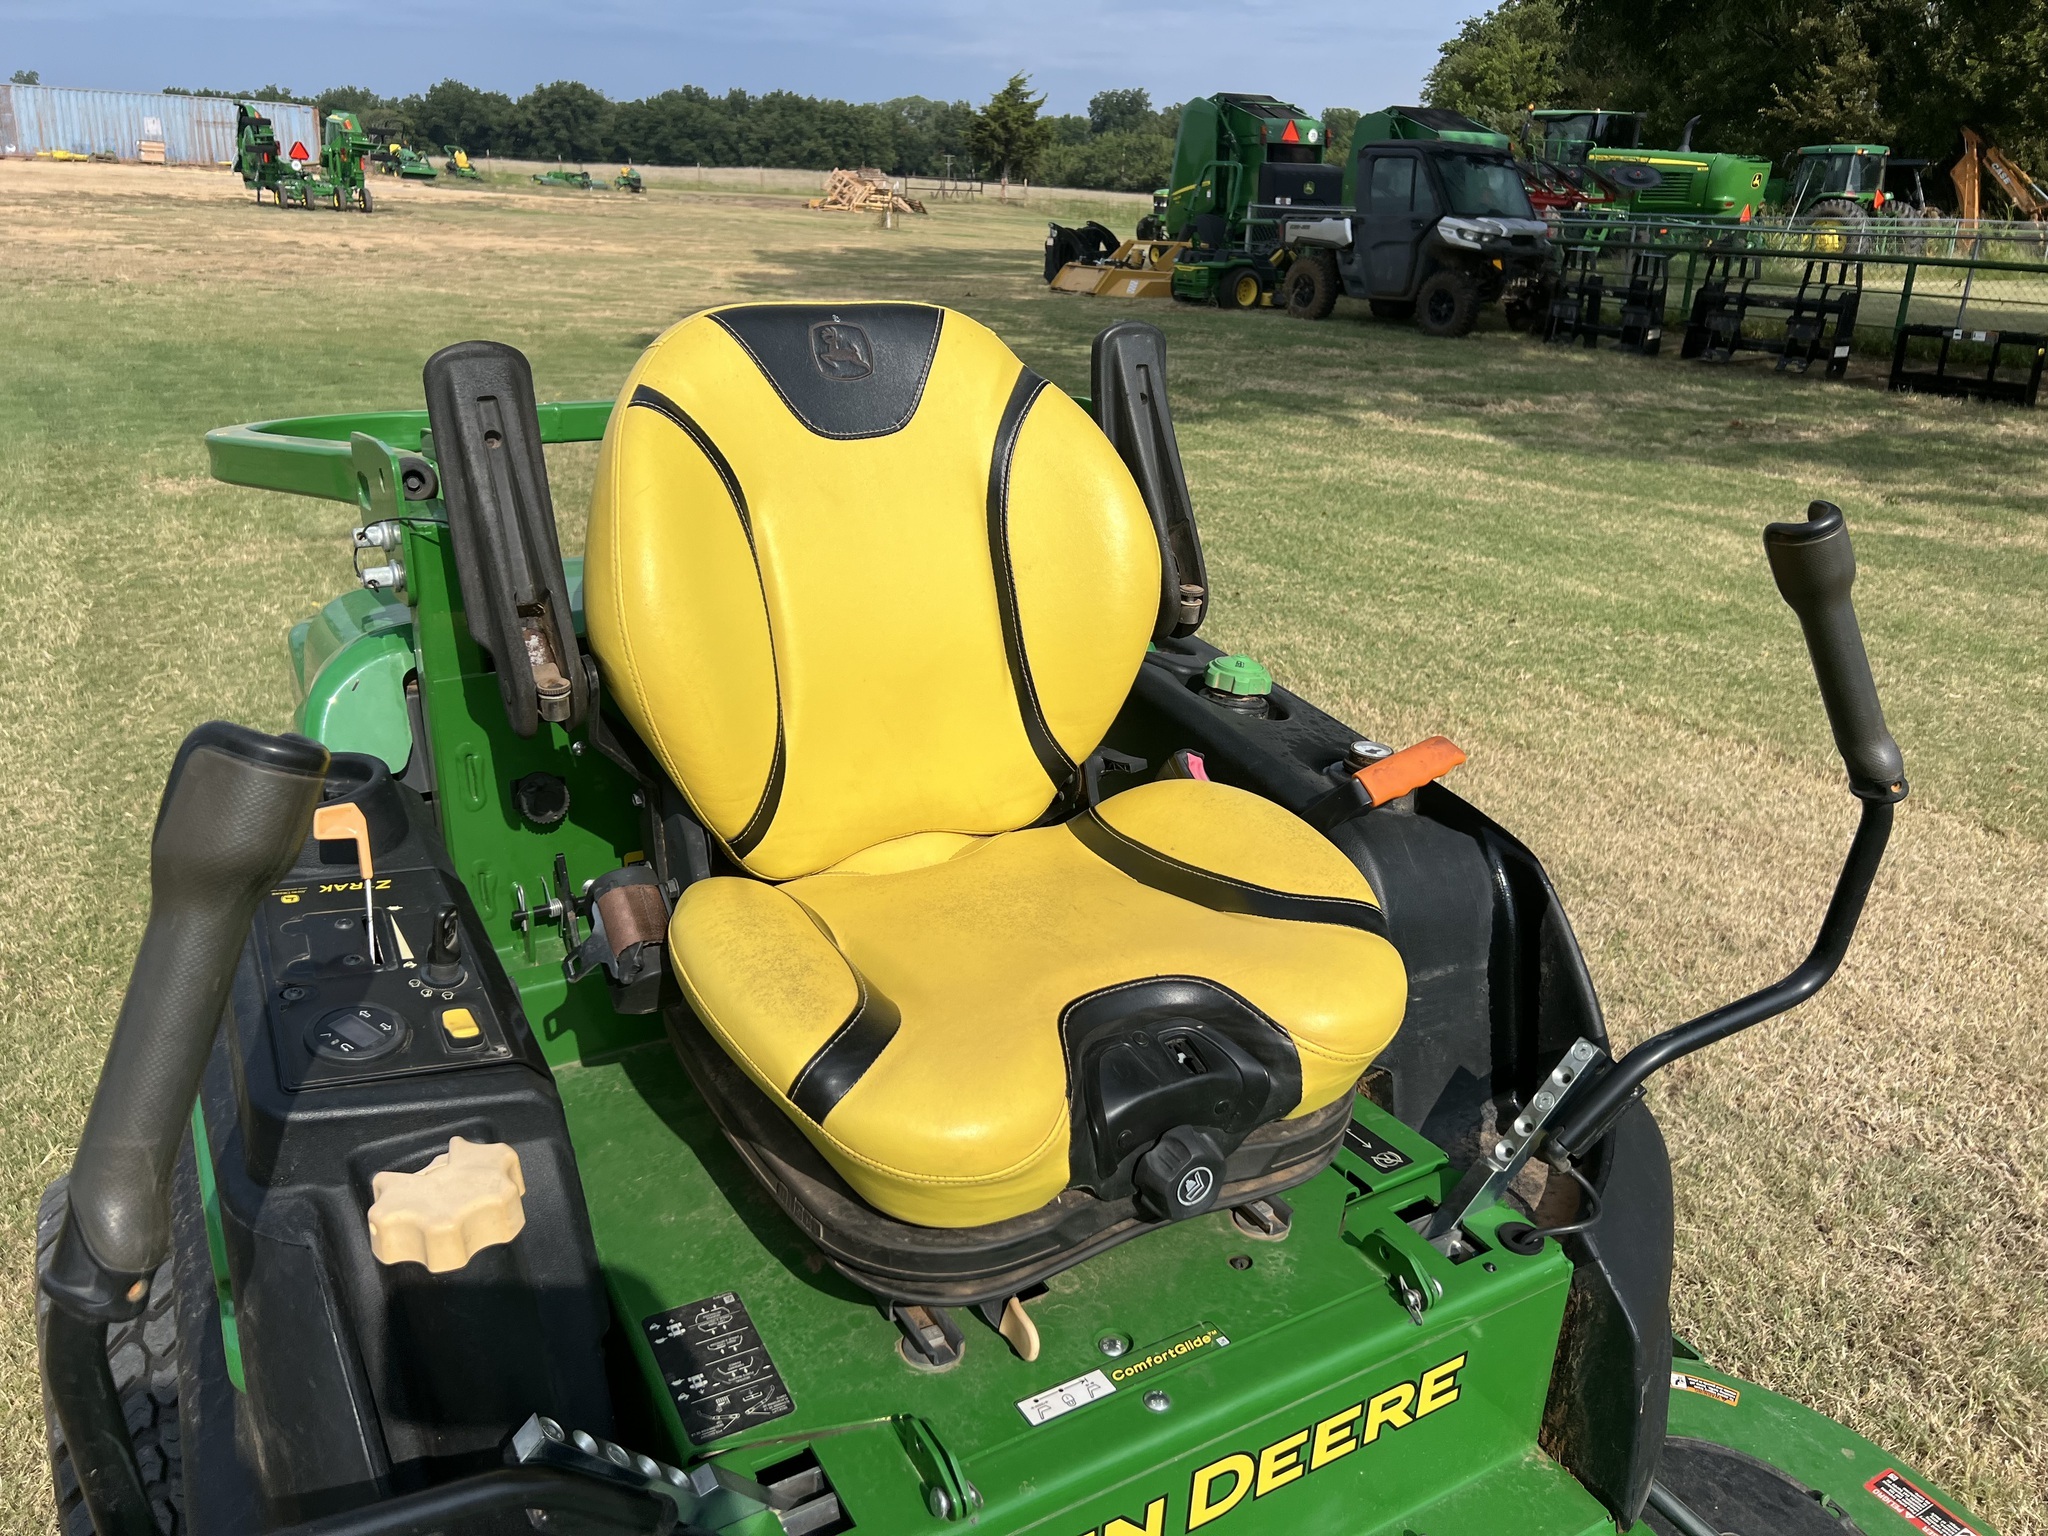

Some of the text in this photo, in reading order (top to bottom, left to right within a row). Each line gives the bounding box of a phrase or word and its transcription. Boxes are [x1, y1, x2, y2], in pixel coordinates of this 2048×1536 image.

[1992, 163, 2010, 184] CASE
[319, 879, 392, 893] ZRAK
[1186, 1352, 1466, 1532] DEERE
